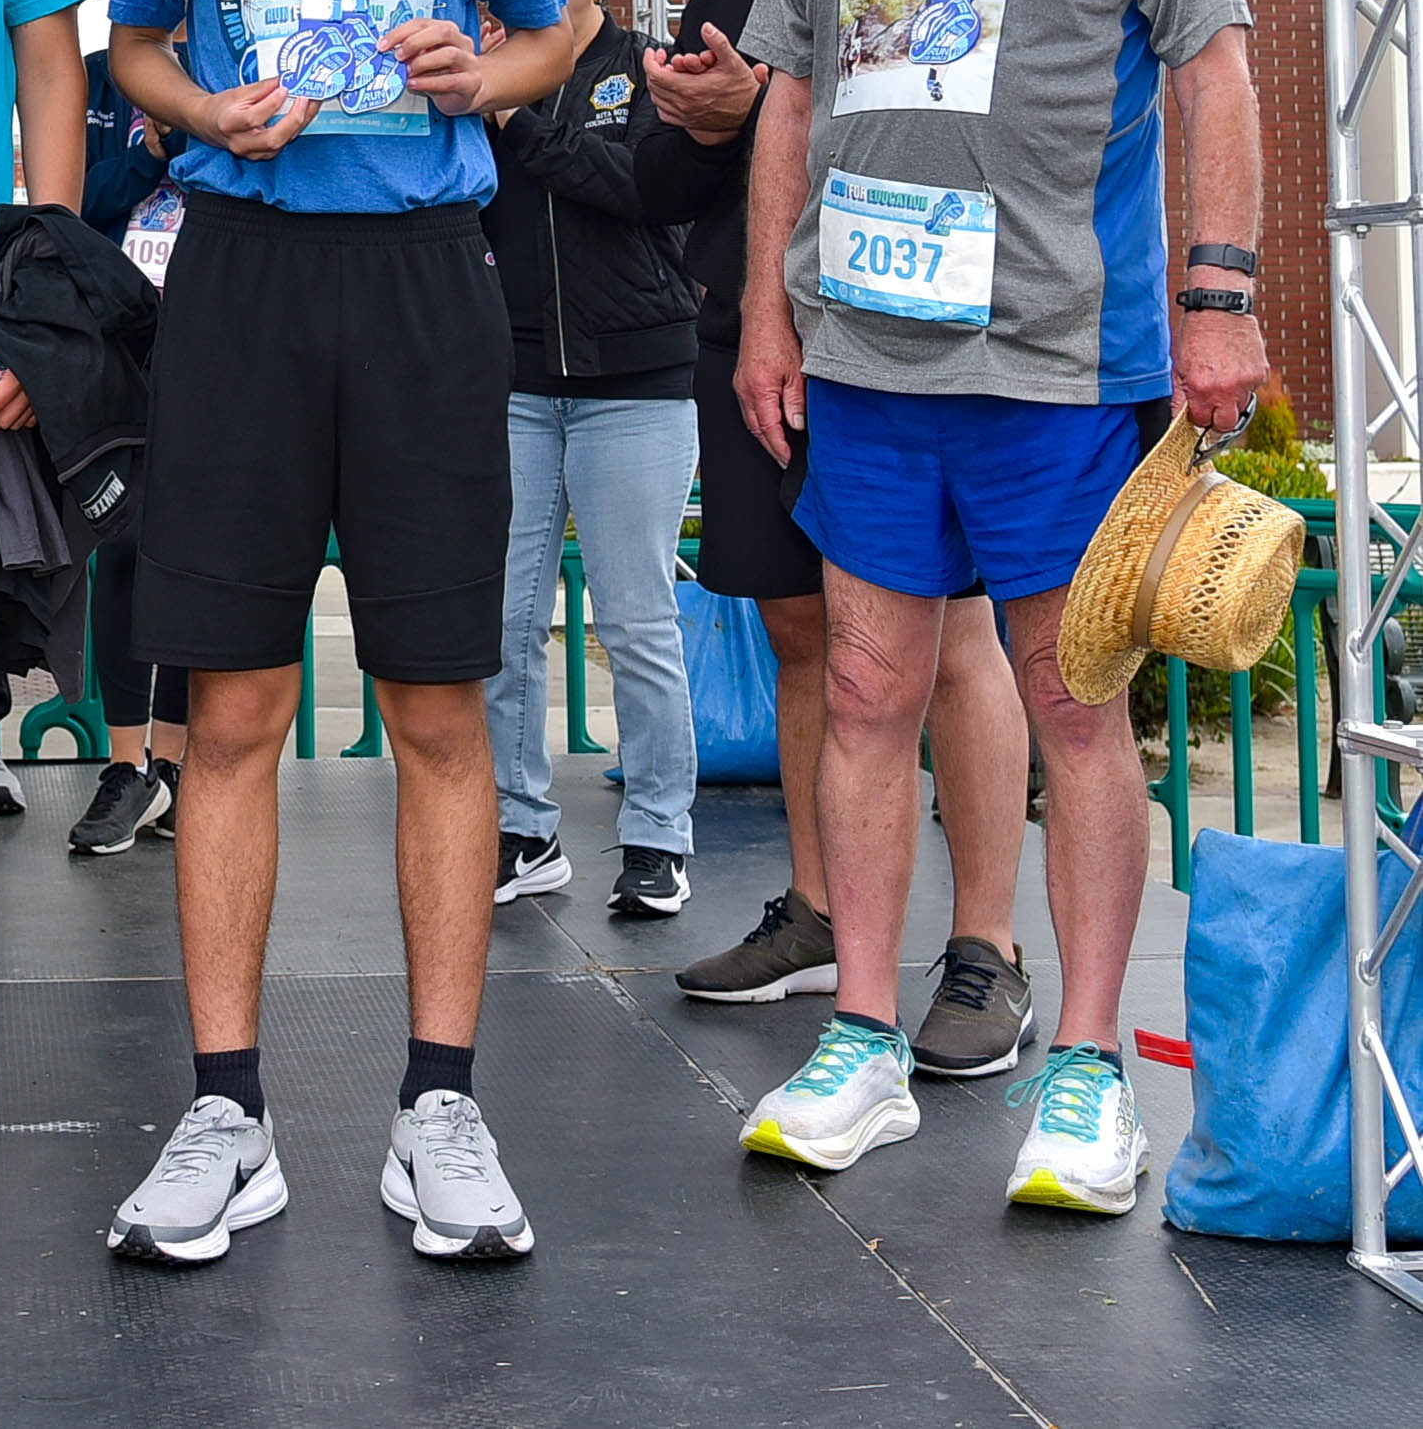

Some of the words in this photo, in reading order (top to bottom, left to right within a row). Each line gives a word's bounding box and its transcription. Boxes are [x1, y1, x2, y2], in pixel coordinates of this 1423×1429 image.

[223, 11, 247, 50] RUN
[300, 81, 325, 91] RUN
[363, 91, 386, 102] RUN
[847, 183, 867, 202] FOR
[867, 188, 929, 212] EDUCATION
[848, 229, 944, 283] 2037
